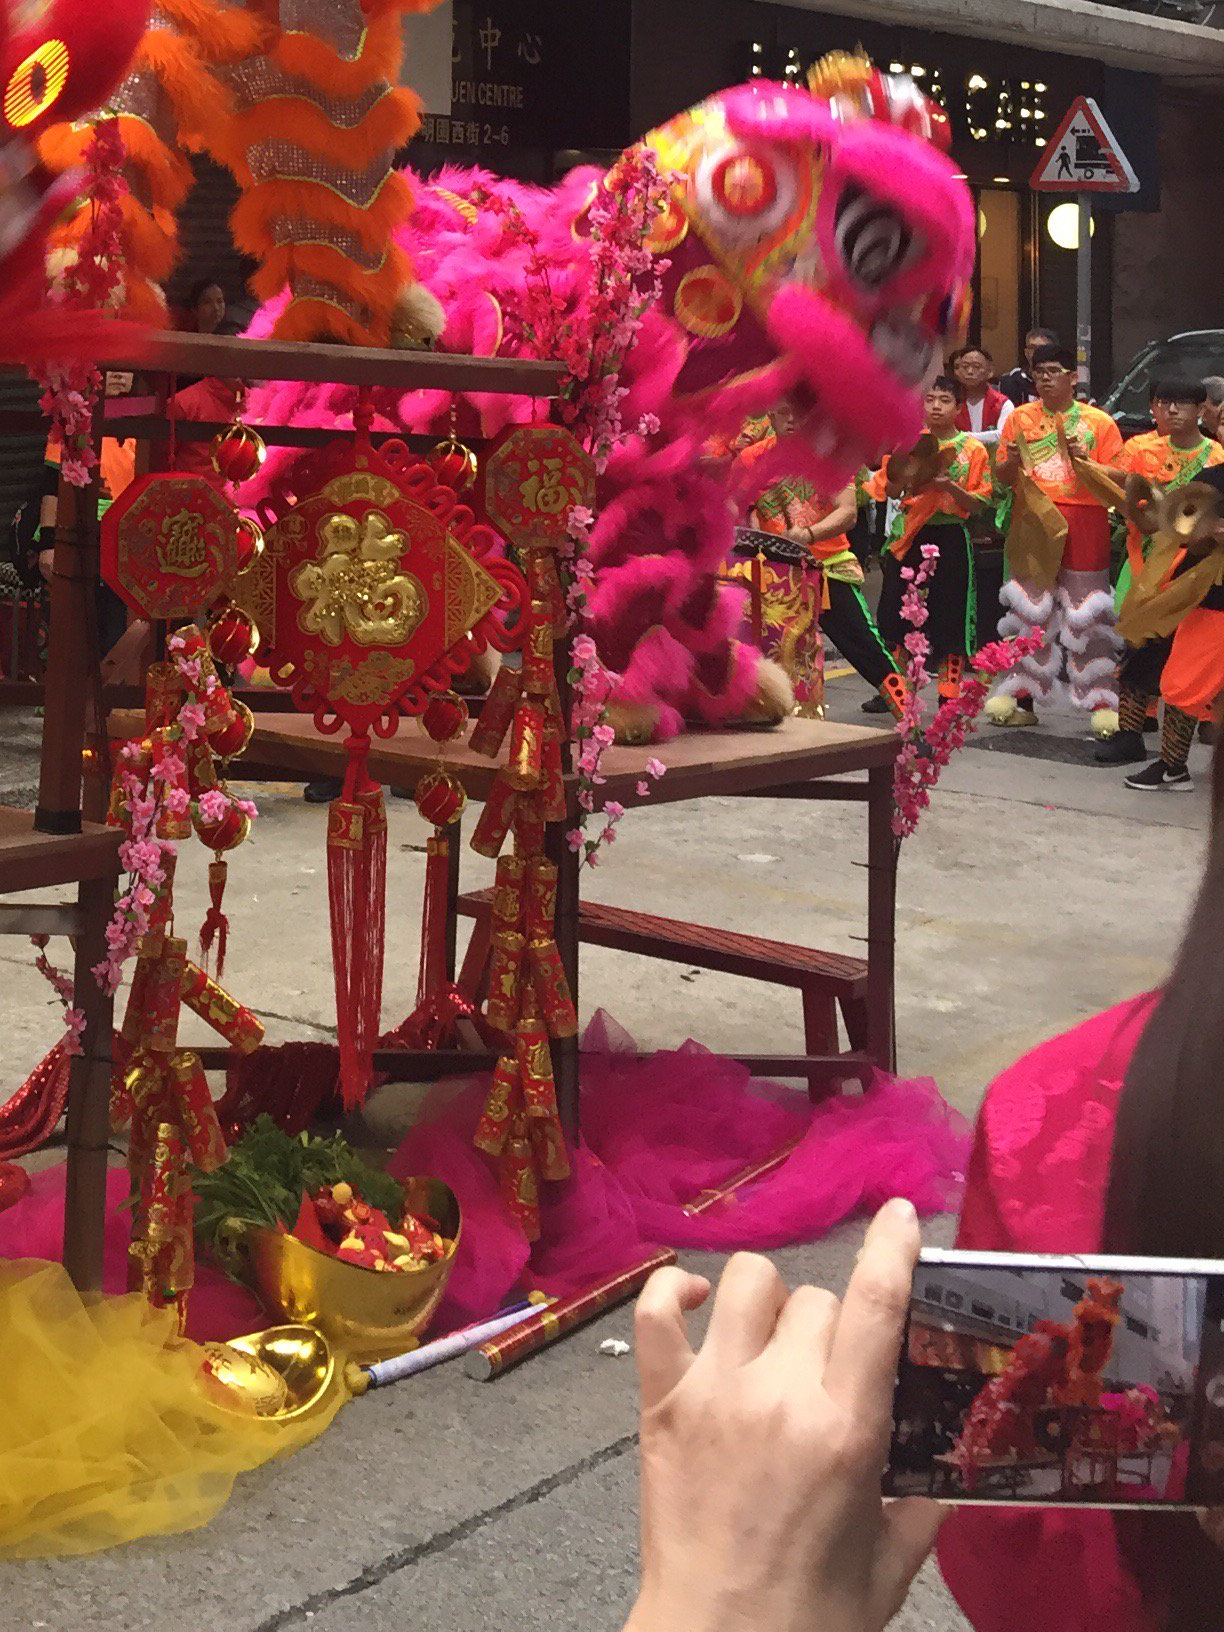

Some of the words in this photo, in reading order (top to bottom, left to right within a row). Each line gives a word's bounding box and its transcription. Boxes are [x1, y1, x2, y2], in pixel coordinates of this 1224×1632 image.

[478, 82, 524, 108] CENTRE
[483, 123, 509, 145] 2-6
[290, 511, 428, 648] 福
